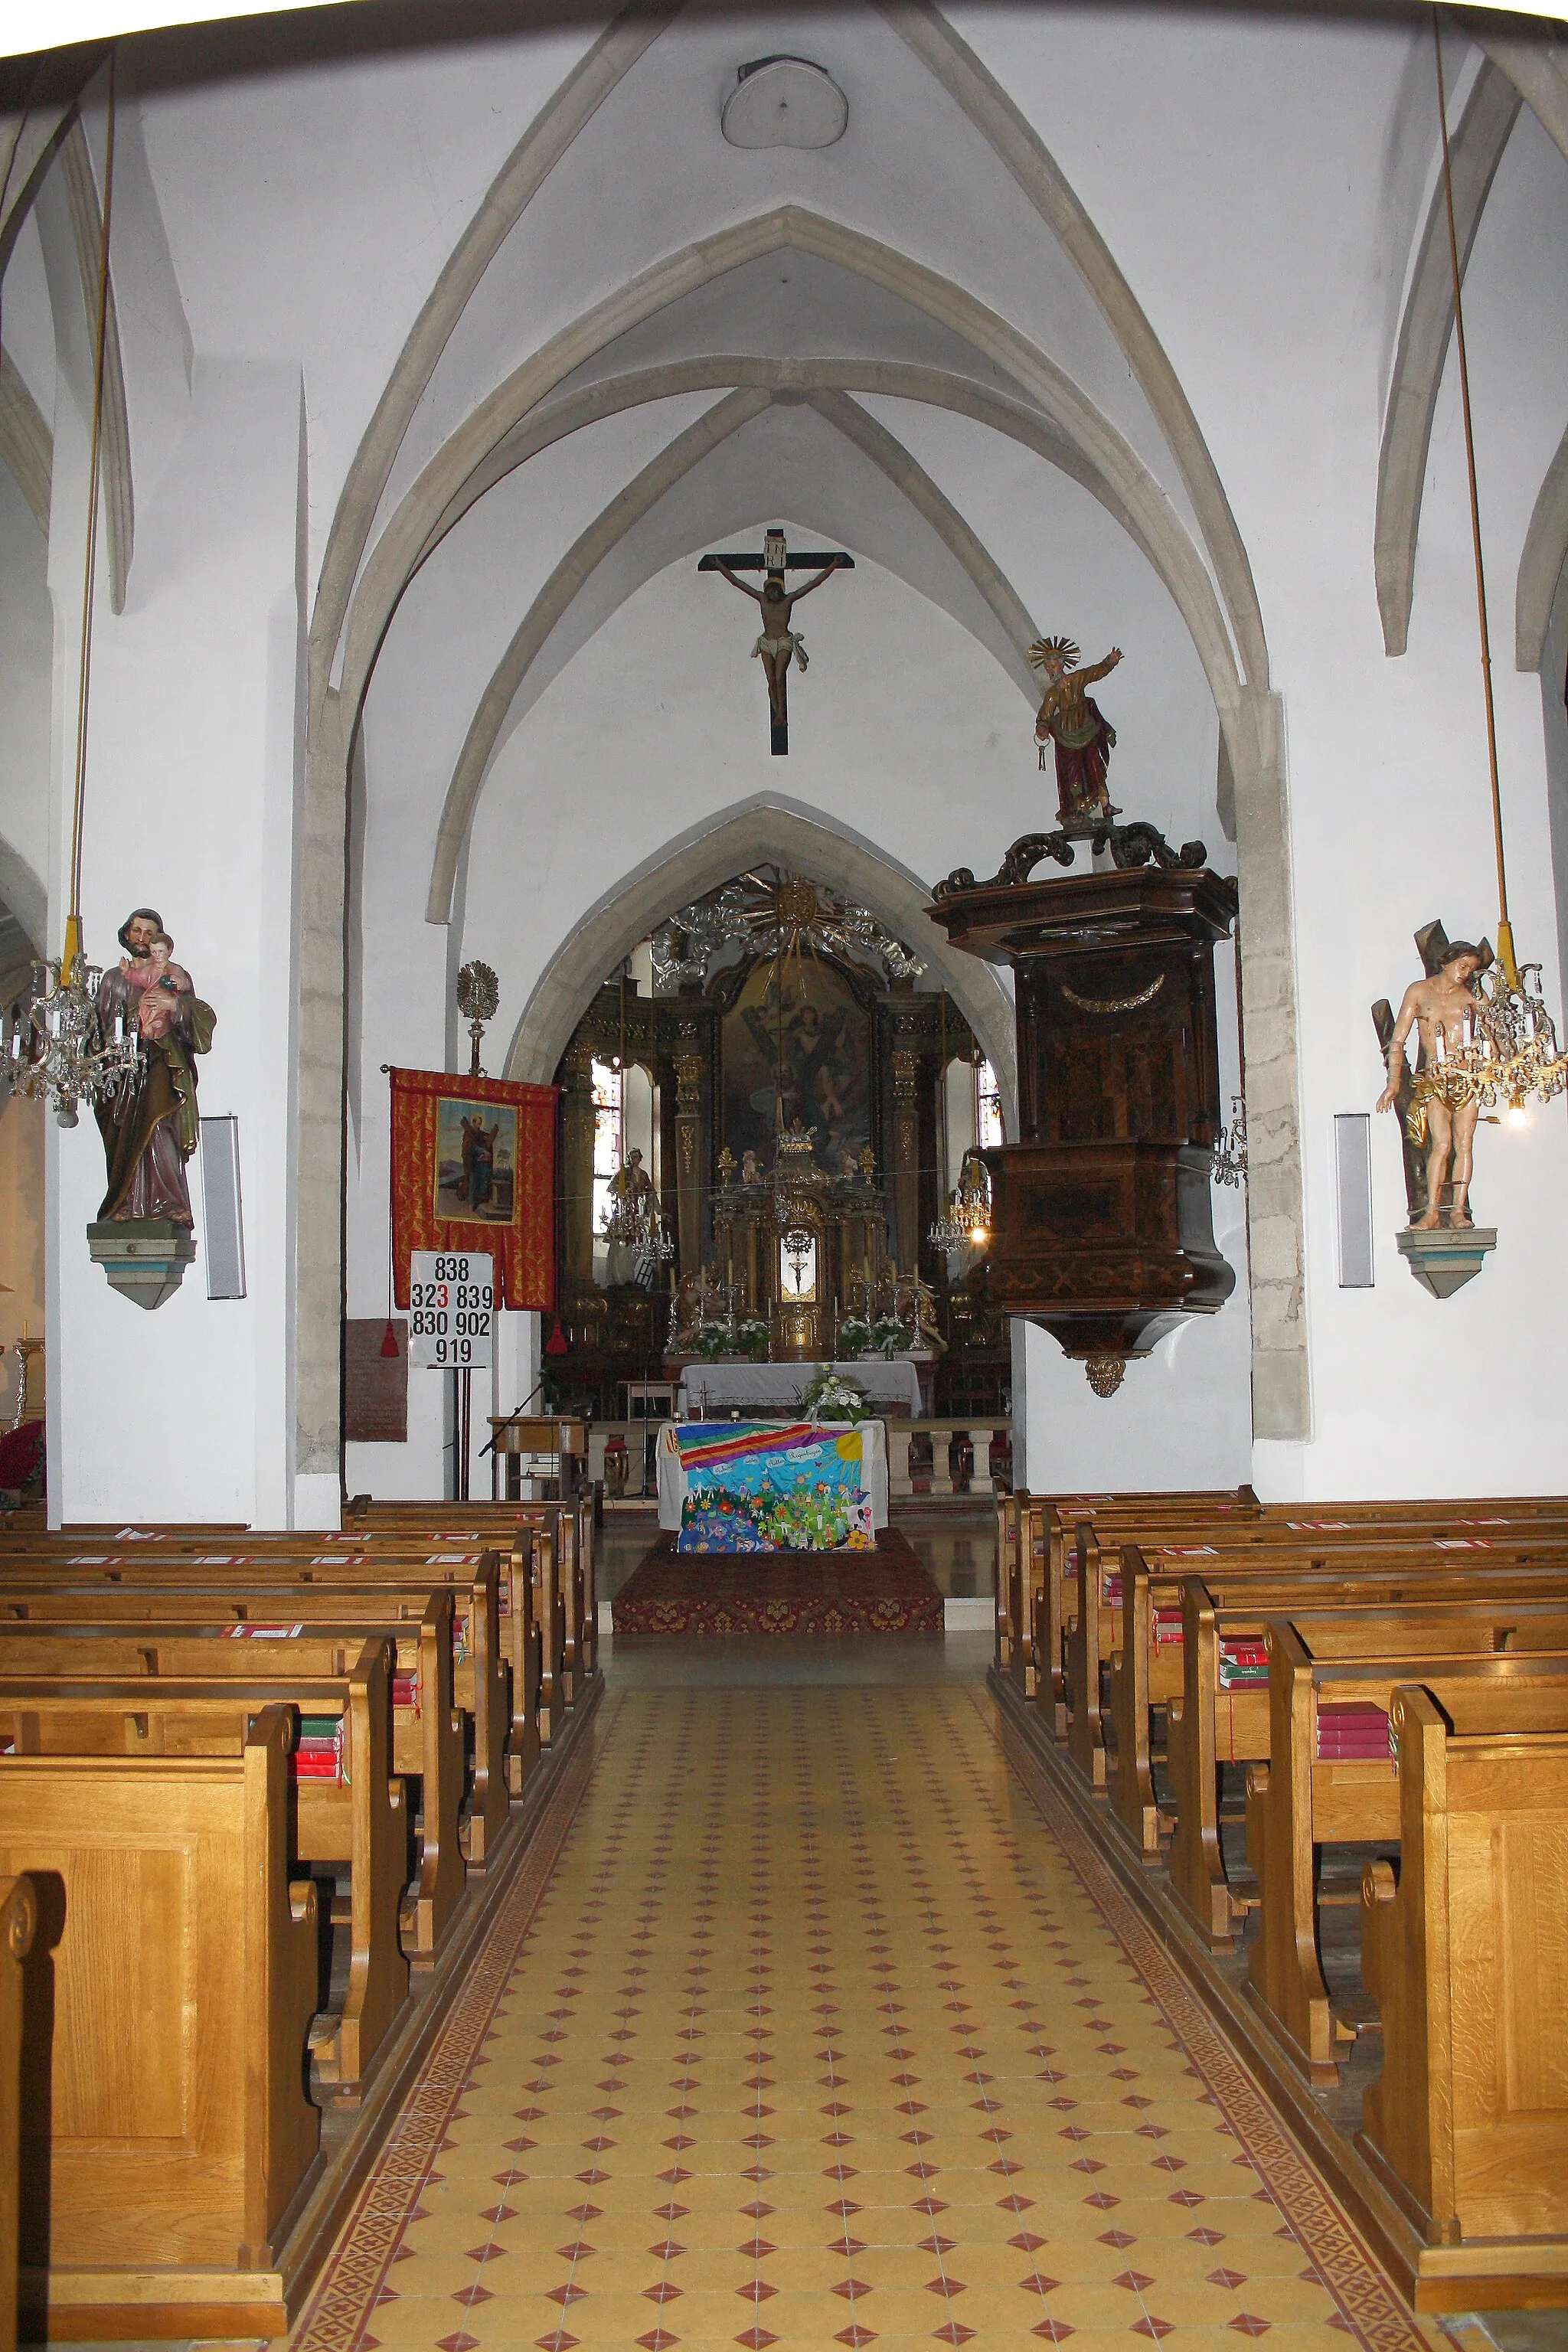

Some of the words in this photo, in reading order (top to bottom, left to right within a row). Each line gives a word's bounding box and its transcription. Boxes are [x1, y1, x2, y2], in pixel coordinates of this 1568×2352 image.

[435, 1257, 469, 1282] 838
[412, 1284, 449, 1308] 323
[456, 1285, 493, 1309] 839
[413, 1311, 448, 1335] 830
[456, 1312, 490, 1336] 902
[436, 1339, 471, 1363] 919
